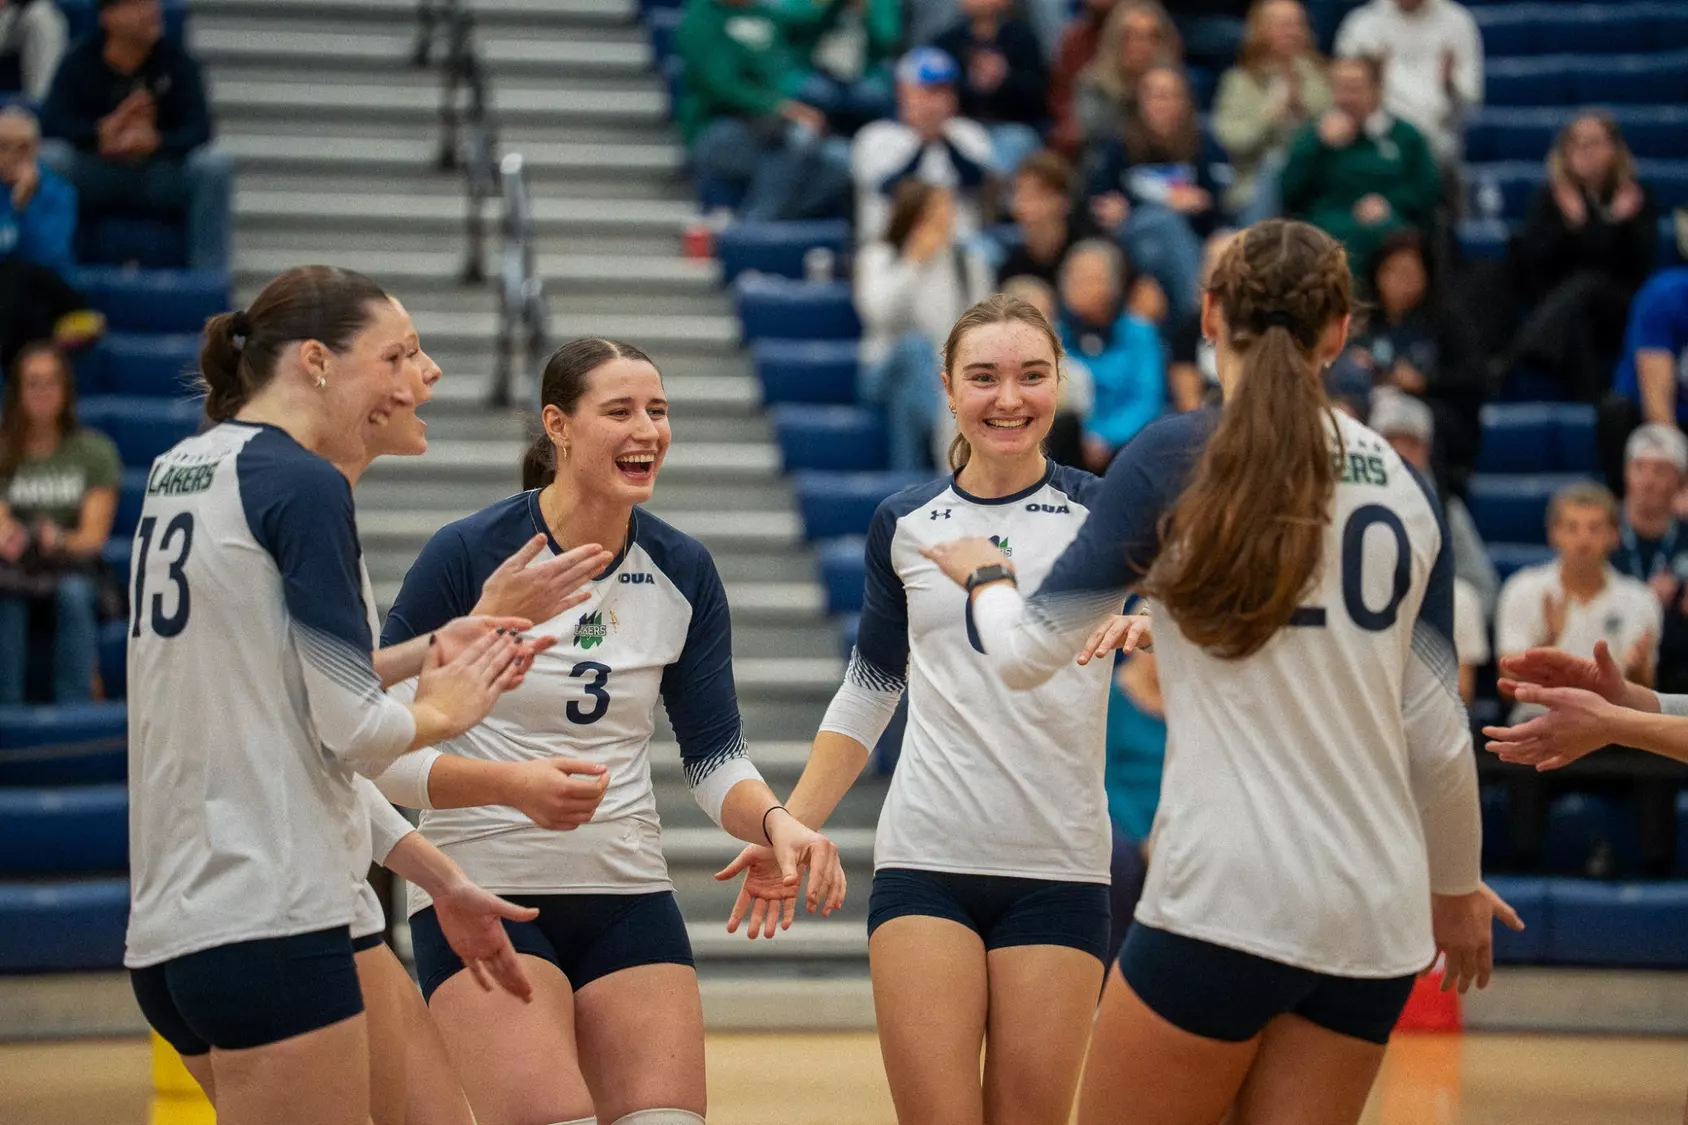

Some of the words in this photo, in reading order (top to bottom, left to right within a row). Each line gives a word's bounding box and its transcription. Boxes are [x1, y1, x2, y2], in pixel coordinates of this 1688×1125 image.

[147, 461, 220, 495] LAKERS
[1025, 503, 1070, 514] OUA
[132, 512, 194, 638] 13
[618, 572, 656, 584] OUA
[574, 624, 607, 636] LAKERS
[566, 661, 612, 724] 3
